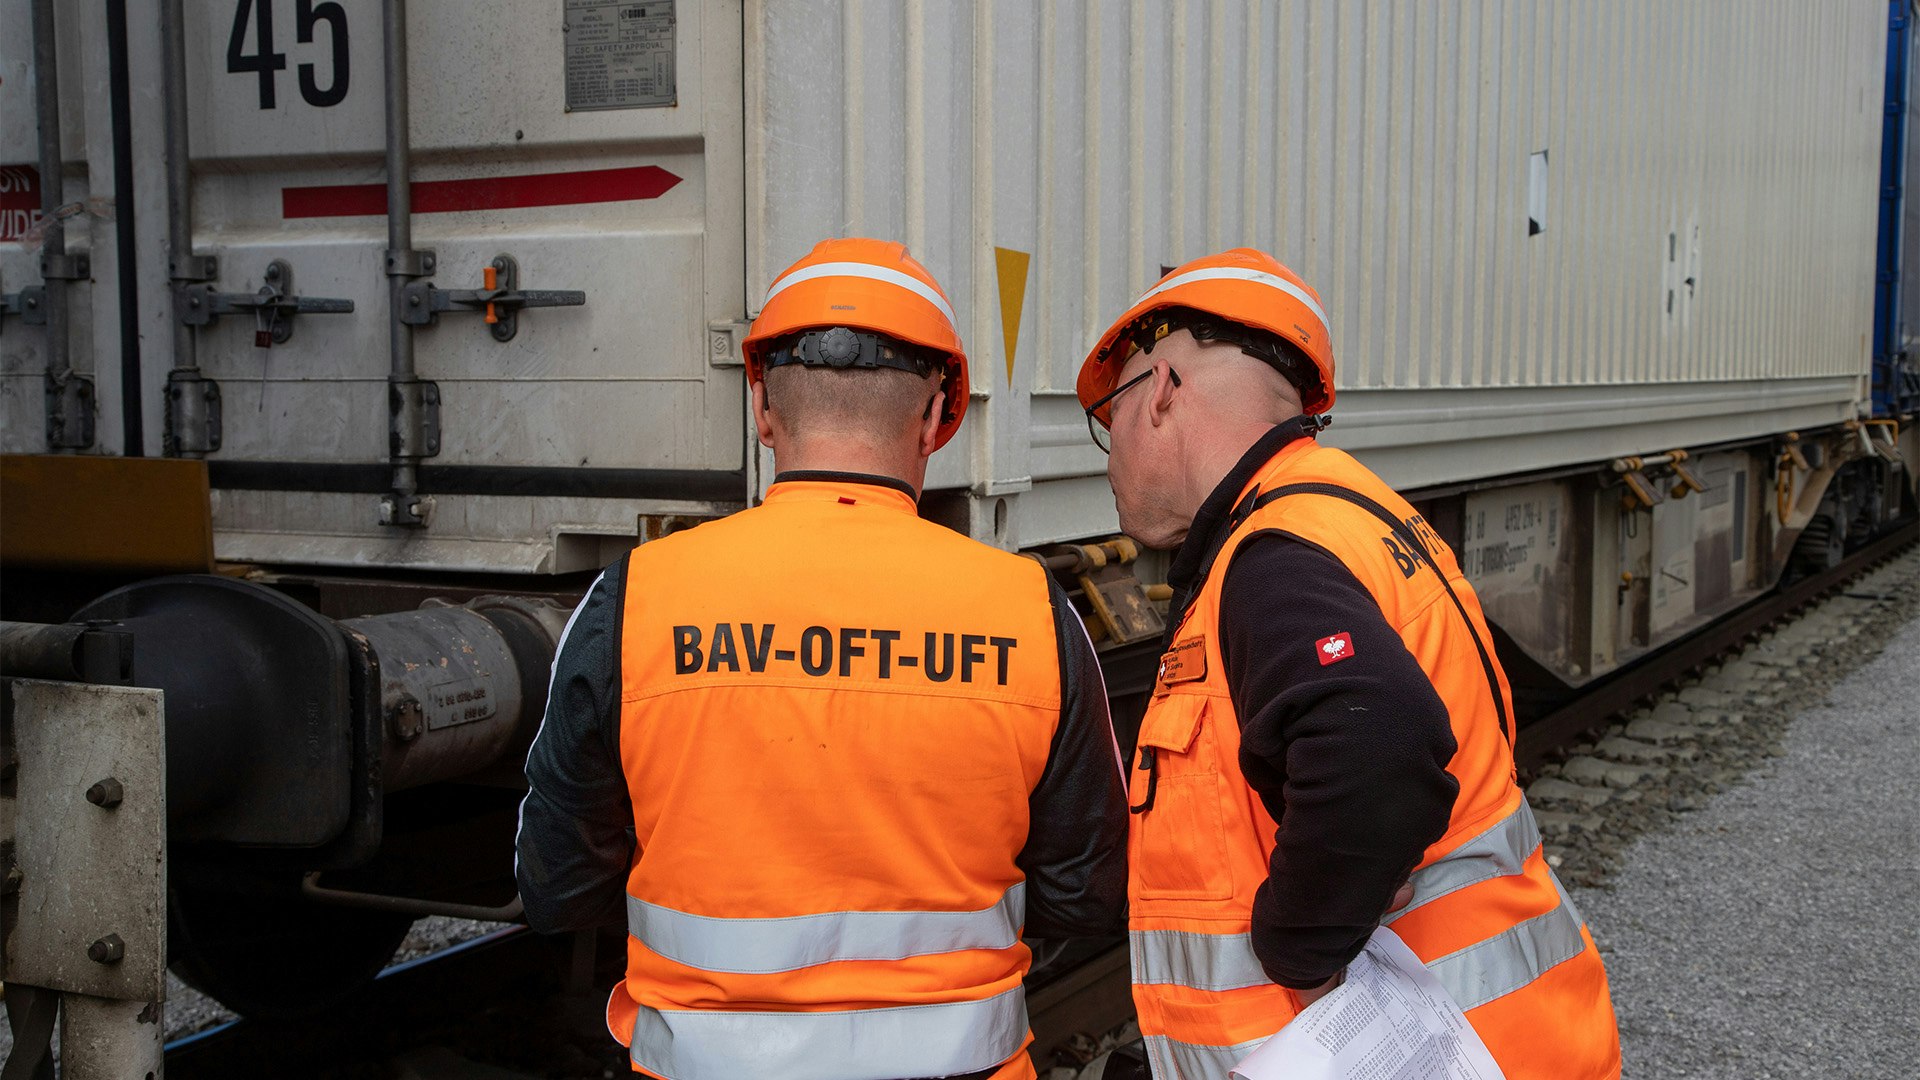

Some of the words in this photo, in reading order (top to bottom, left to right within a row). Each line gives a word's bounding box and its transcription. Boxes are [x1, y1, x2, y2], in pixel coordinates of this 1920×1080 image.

[227, 0, 349, 109] 45
[575, 46, 590, 54] CSC
[593, 44, 623, 53] SAFETY
[625, 41, 665, 51] APPROVAL
[673, 623, 1017, 686] BAV-OFT-UFT
